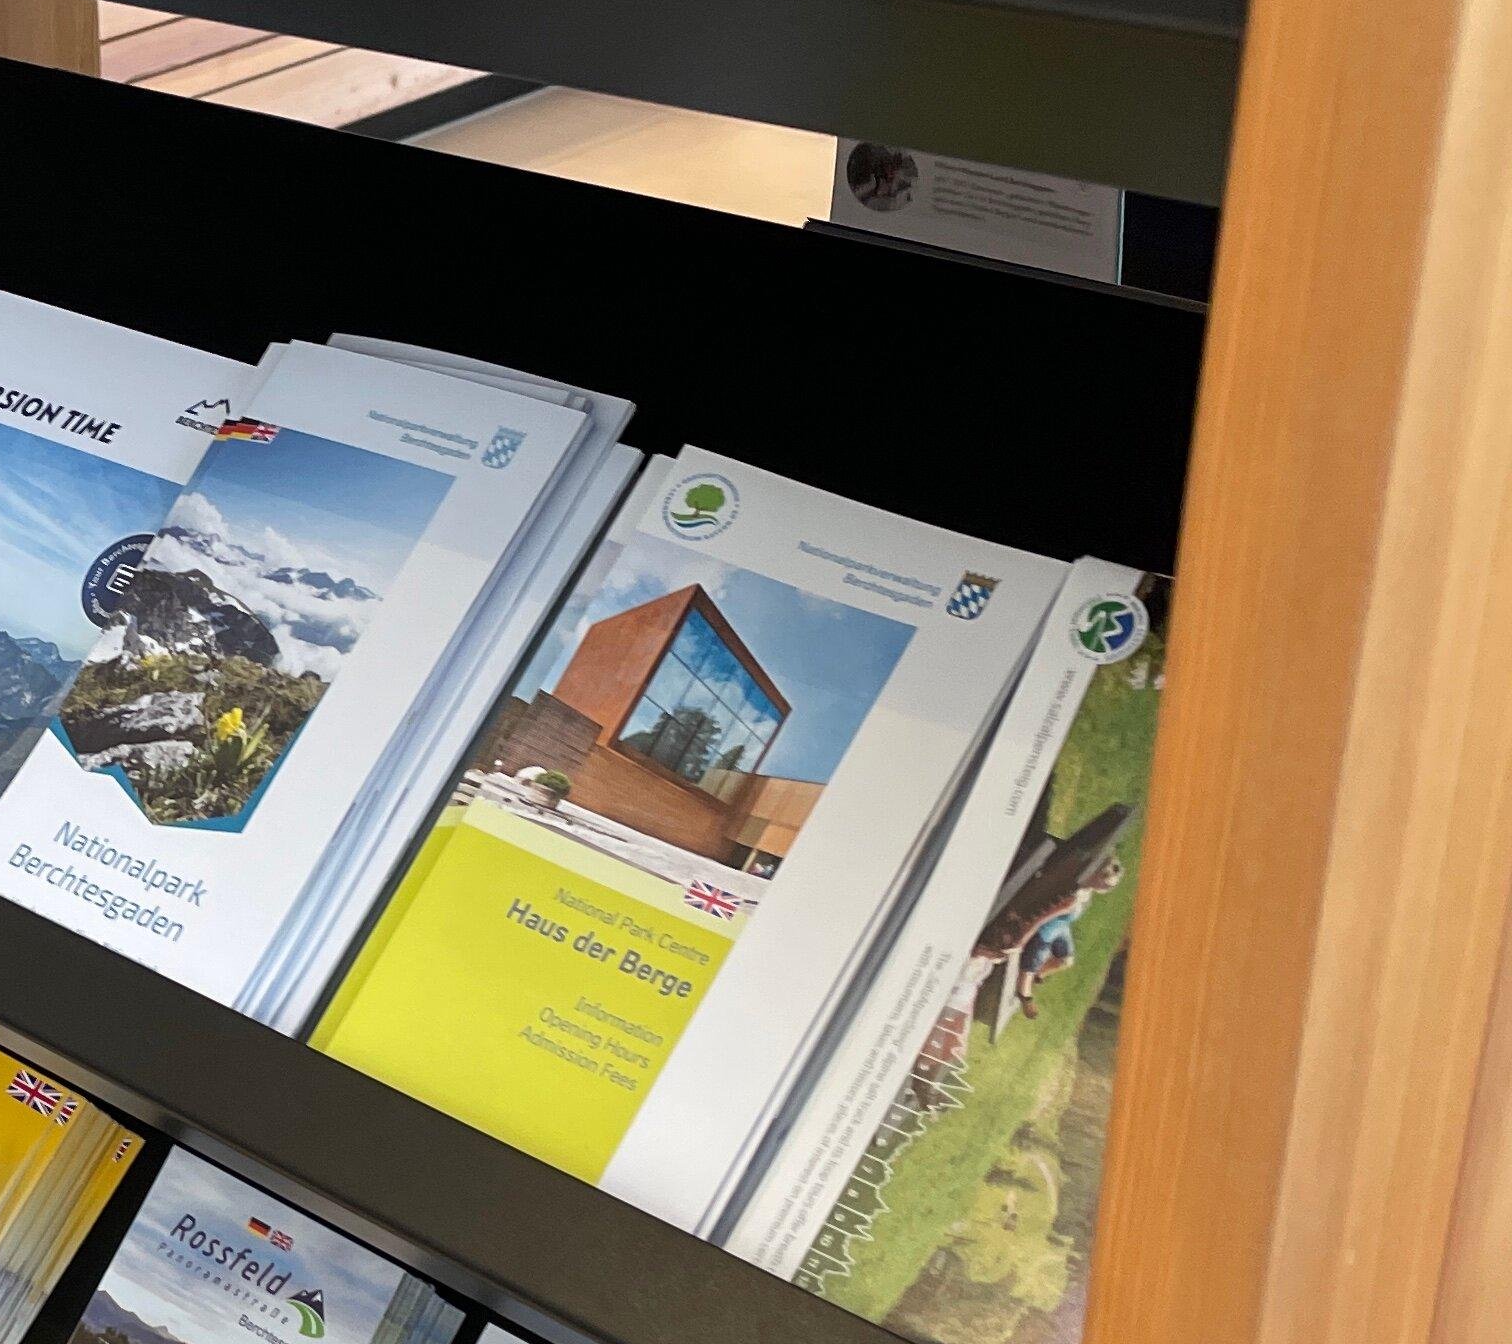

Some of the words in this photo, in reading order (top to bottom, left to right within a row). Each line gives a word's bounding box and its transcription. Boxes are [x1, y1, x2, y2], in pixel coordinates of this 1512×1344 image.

[61, 410, 121, 444] TIME
[8, 843, 185, 942] Berchtesgaden
[53, 821, 207, 907] Nationalpark
[507, 898, 566, 943] Haus
[573, 931, 617, 963] der
[618, 949, 692, 999] Berge
[554, 888, 617, 926] National
[621, 916, 655, 942] Park
[658, 933, 710, 966] Centre
[519, 1026, 598, 1072] Admission
[600, 1062, 638, 1091] Fees
[538, 1007, 600, 1051] Opening
[604, 1036, 650, 1069] Hours
[574, 996, 663, 1047] Information
[170, 1214, 293, 1296] Rossfeld
